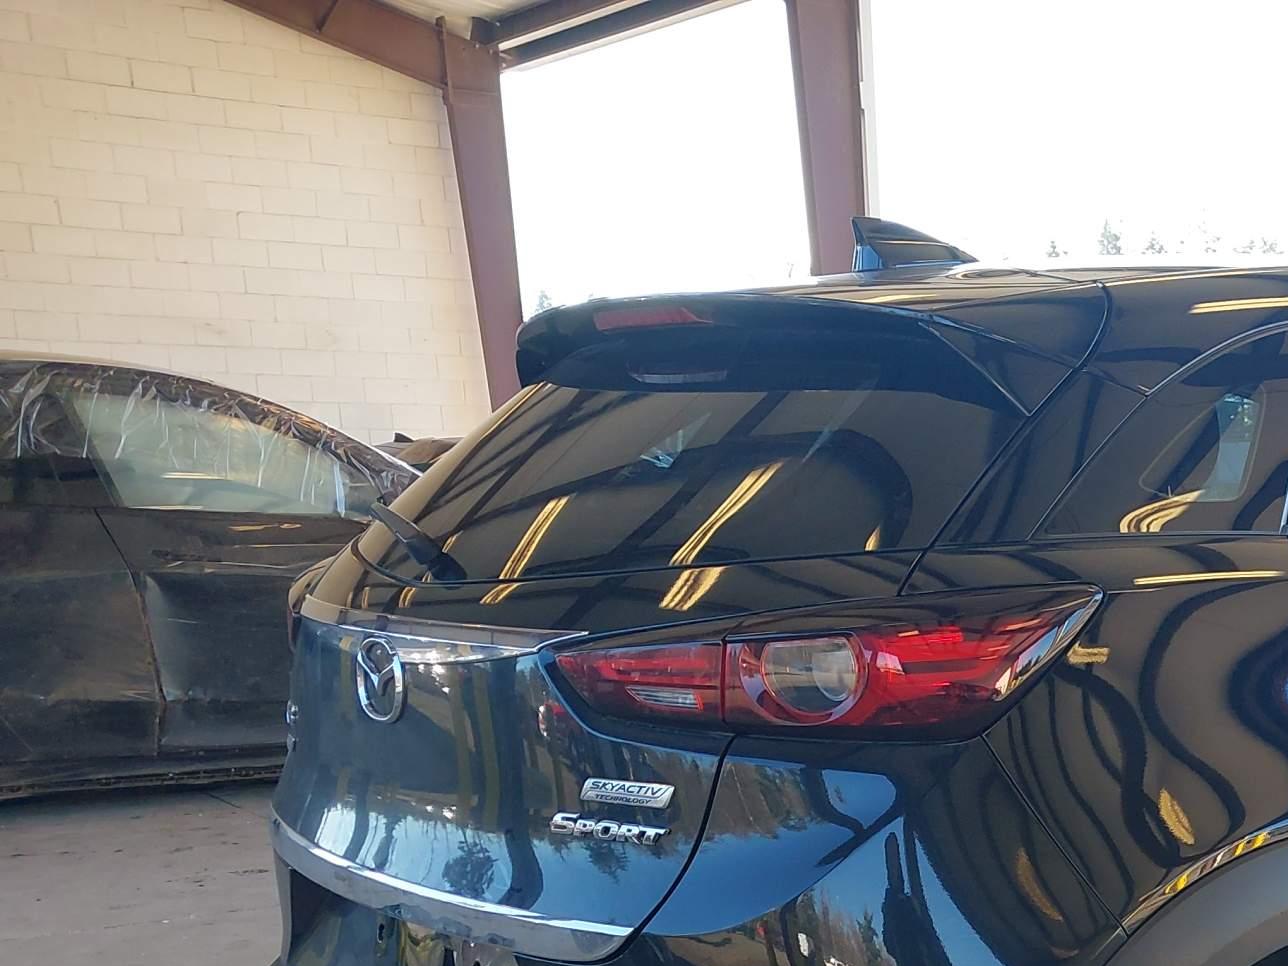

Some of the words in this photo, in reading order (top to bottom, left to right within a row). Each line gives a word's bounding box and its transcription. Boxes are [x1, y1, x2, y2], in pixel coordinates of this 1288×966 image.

[590, 780, 663, 796] SKYACTIV
[595, 793, 652, 805] TECHNOLOGY
[550, 812, 671, 845] SPORT
